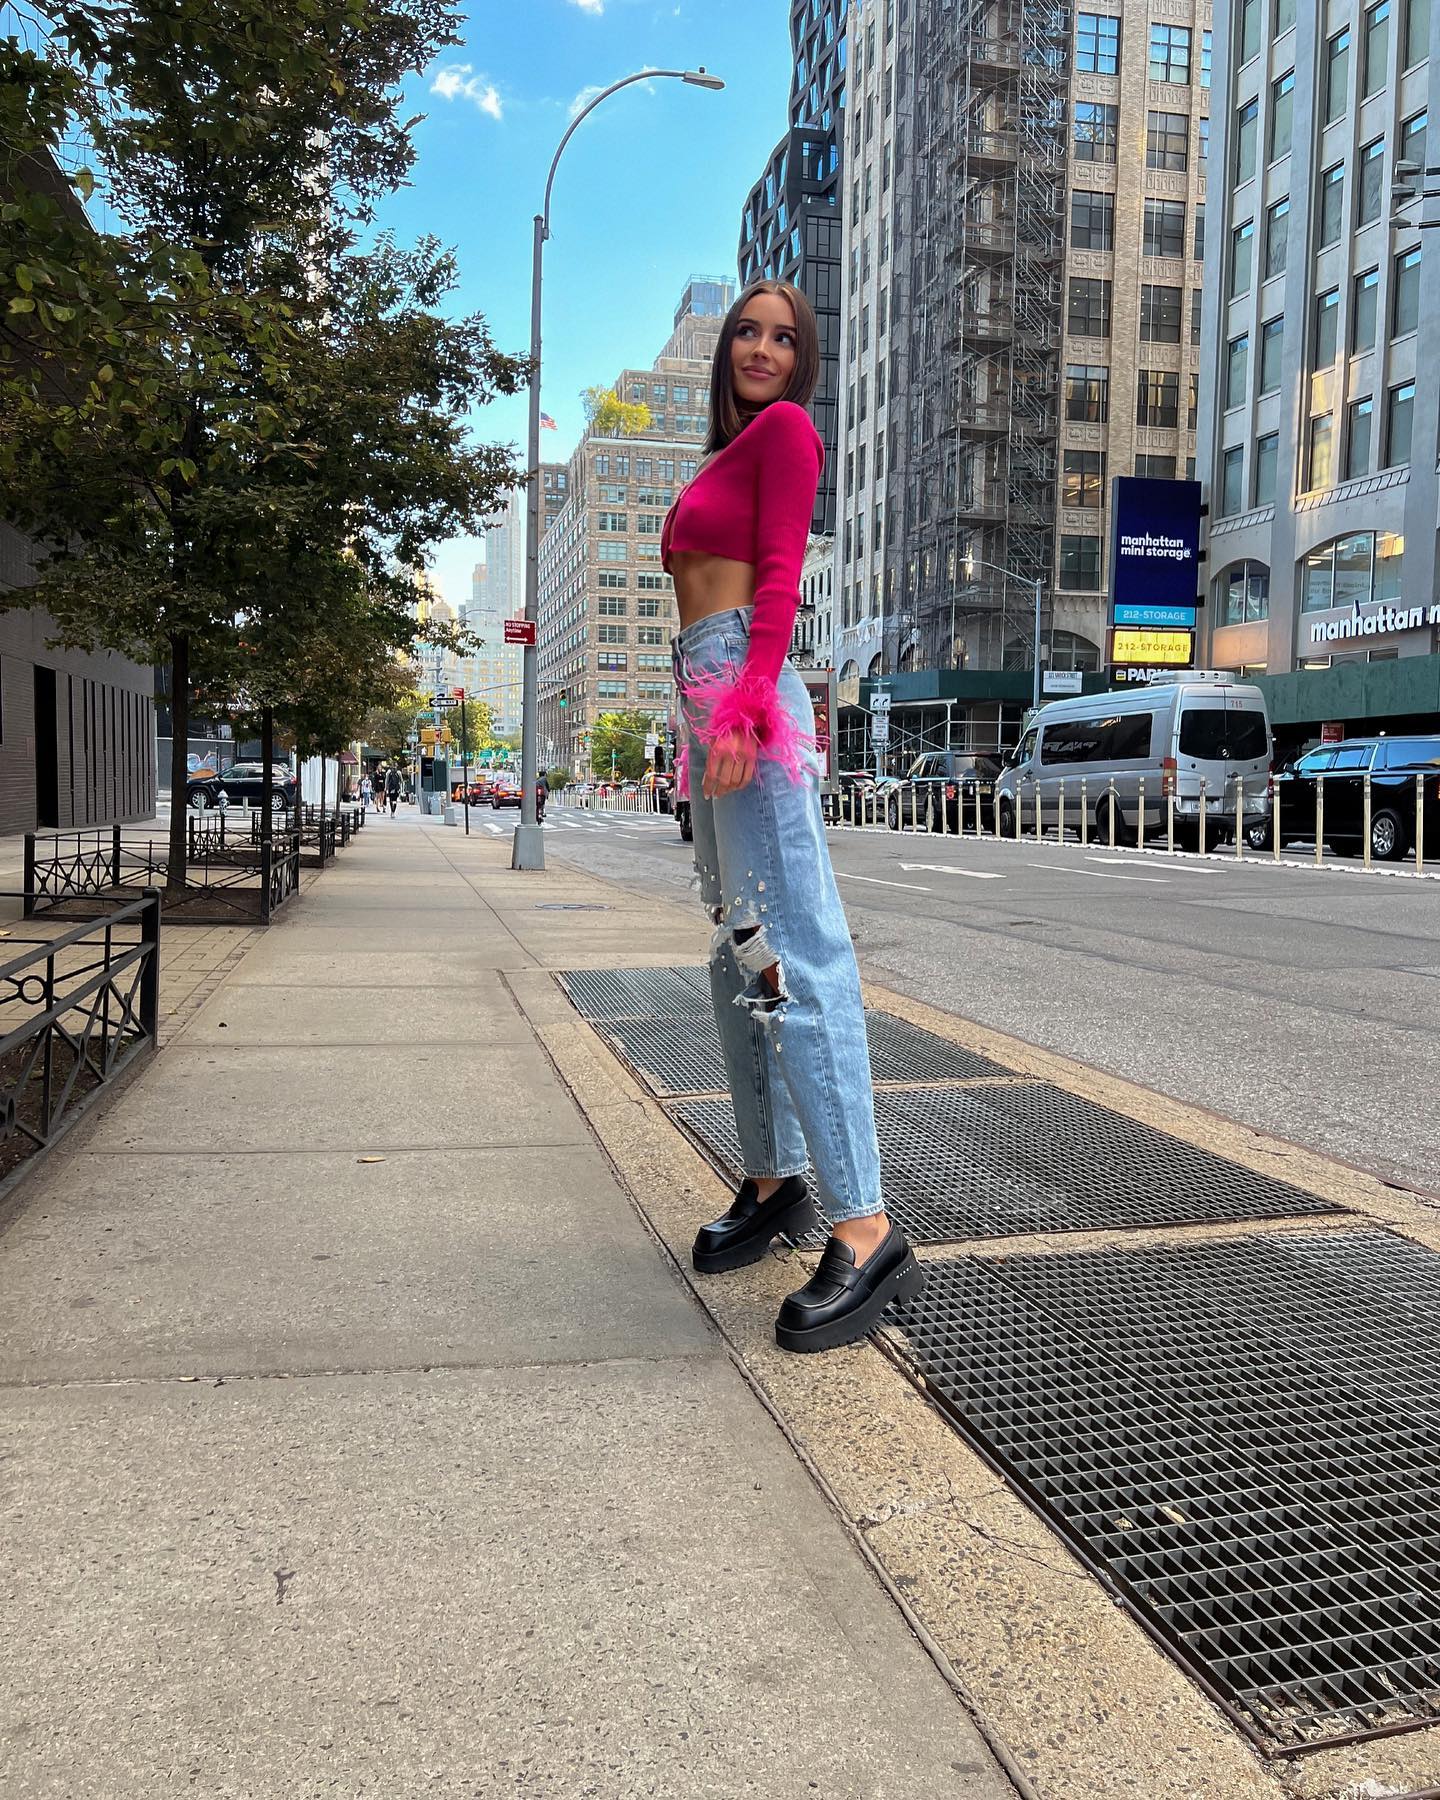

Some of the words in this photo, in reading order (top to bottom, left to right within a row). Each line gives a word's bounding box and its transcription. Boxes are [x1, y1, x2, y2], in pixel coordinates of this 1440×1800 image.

[1121, 531, 1184, 548] manhattan
[1120, 545, 1145, 556] mini
[1146, 547, 1190, 561] storage
[1123, 609, 1188, 621] 212-STORAGE
[1311, 600, 1424, 642] manhattan
[1118, 642, 1188, 652] 212-STORAGE
[1127, 668, 1169, 681] PAR
